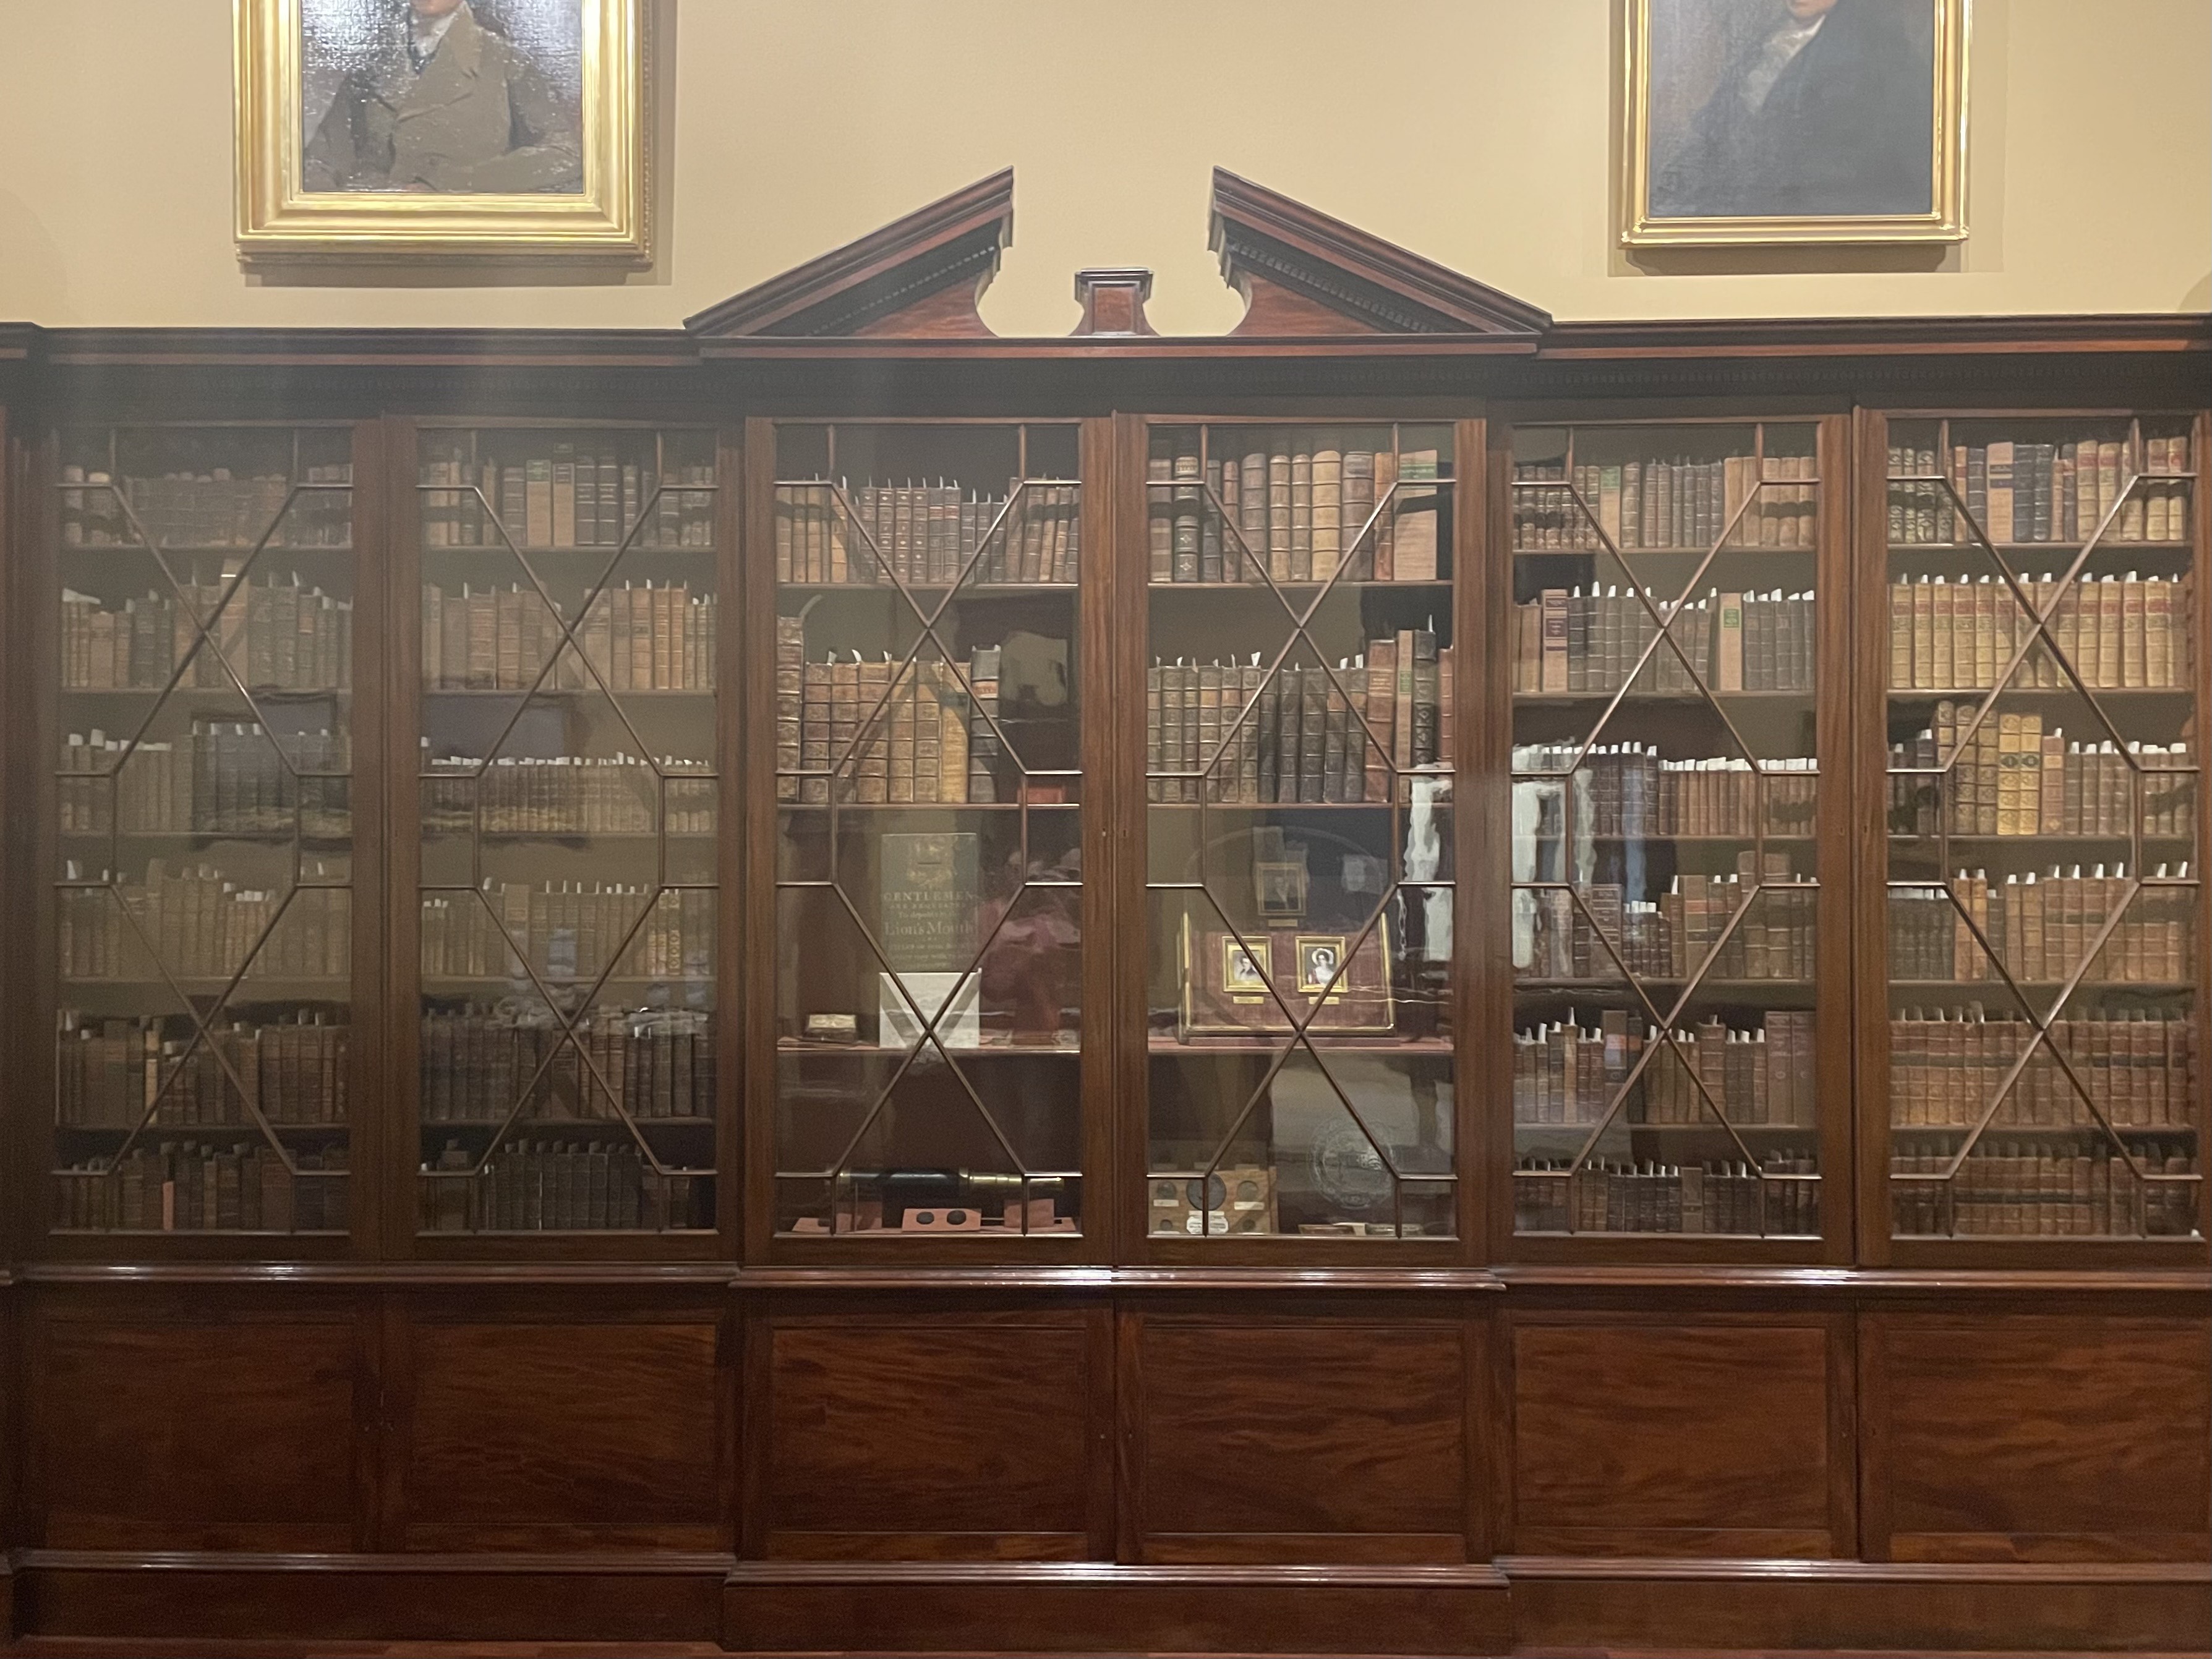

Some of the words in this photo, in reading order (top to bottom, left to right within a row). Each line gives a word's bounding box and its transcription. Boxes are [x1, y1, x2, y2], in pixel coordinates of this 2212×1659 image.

[883, 890, 975, 902] GENTLEMEN
[884, 921, 925, 935] Lion's
[926, 921, 974, 935] Mouth
